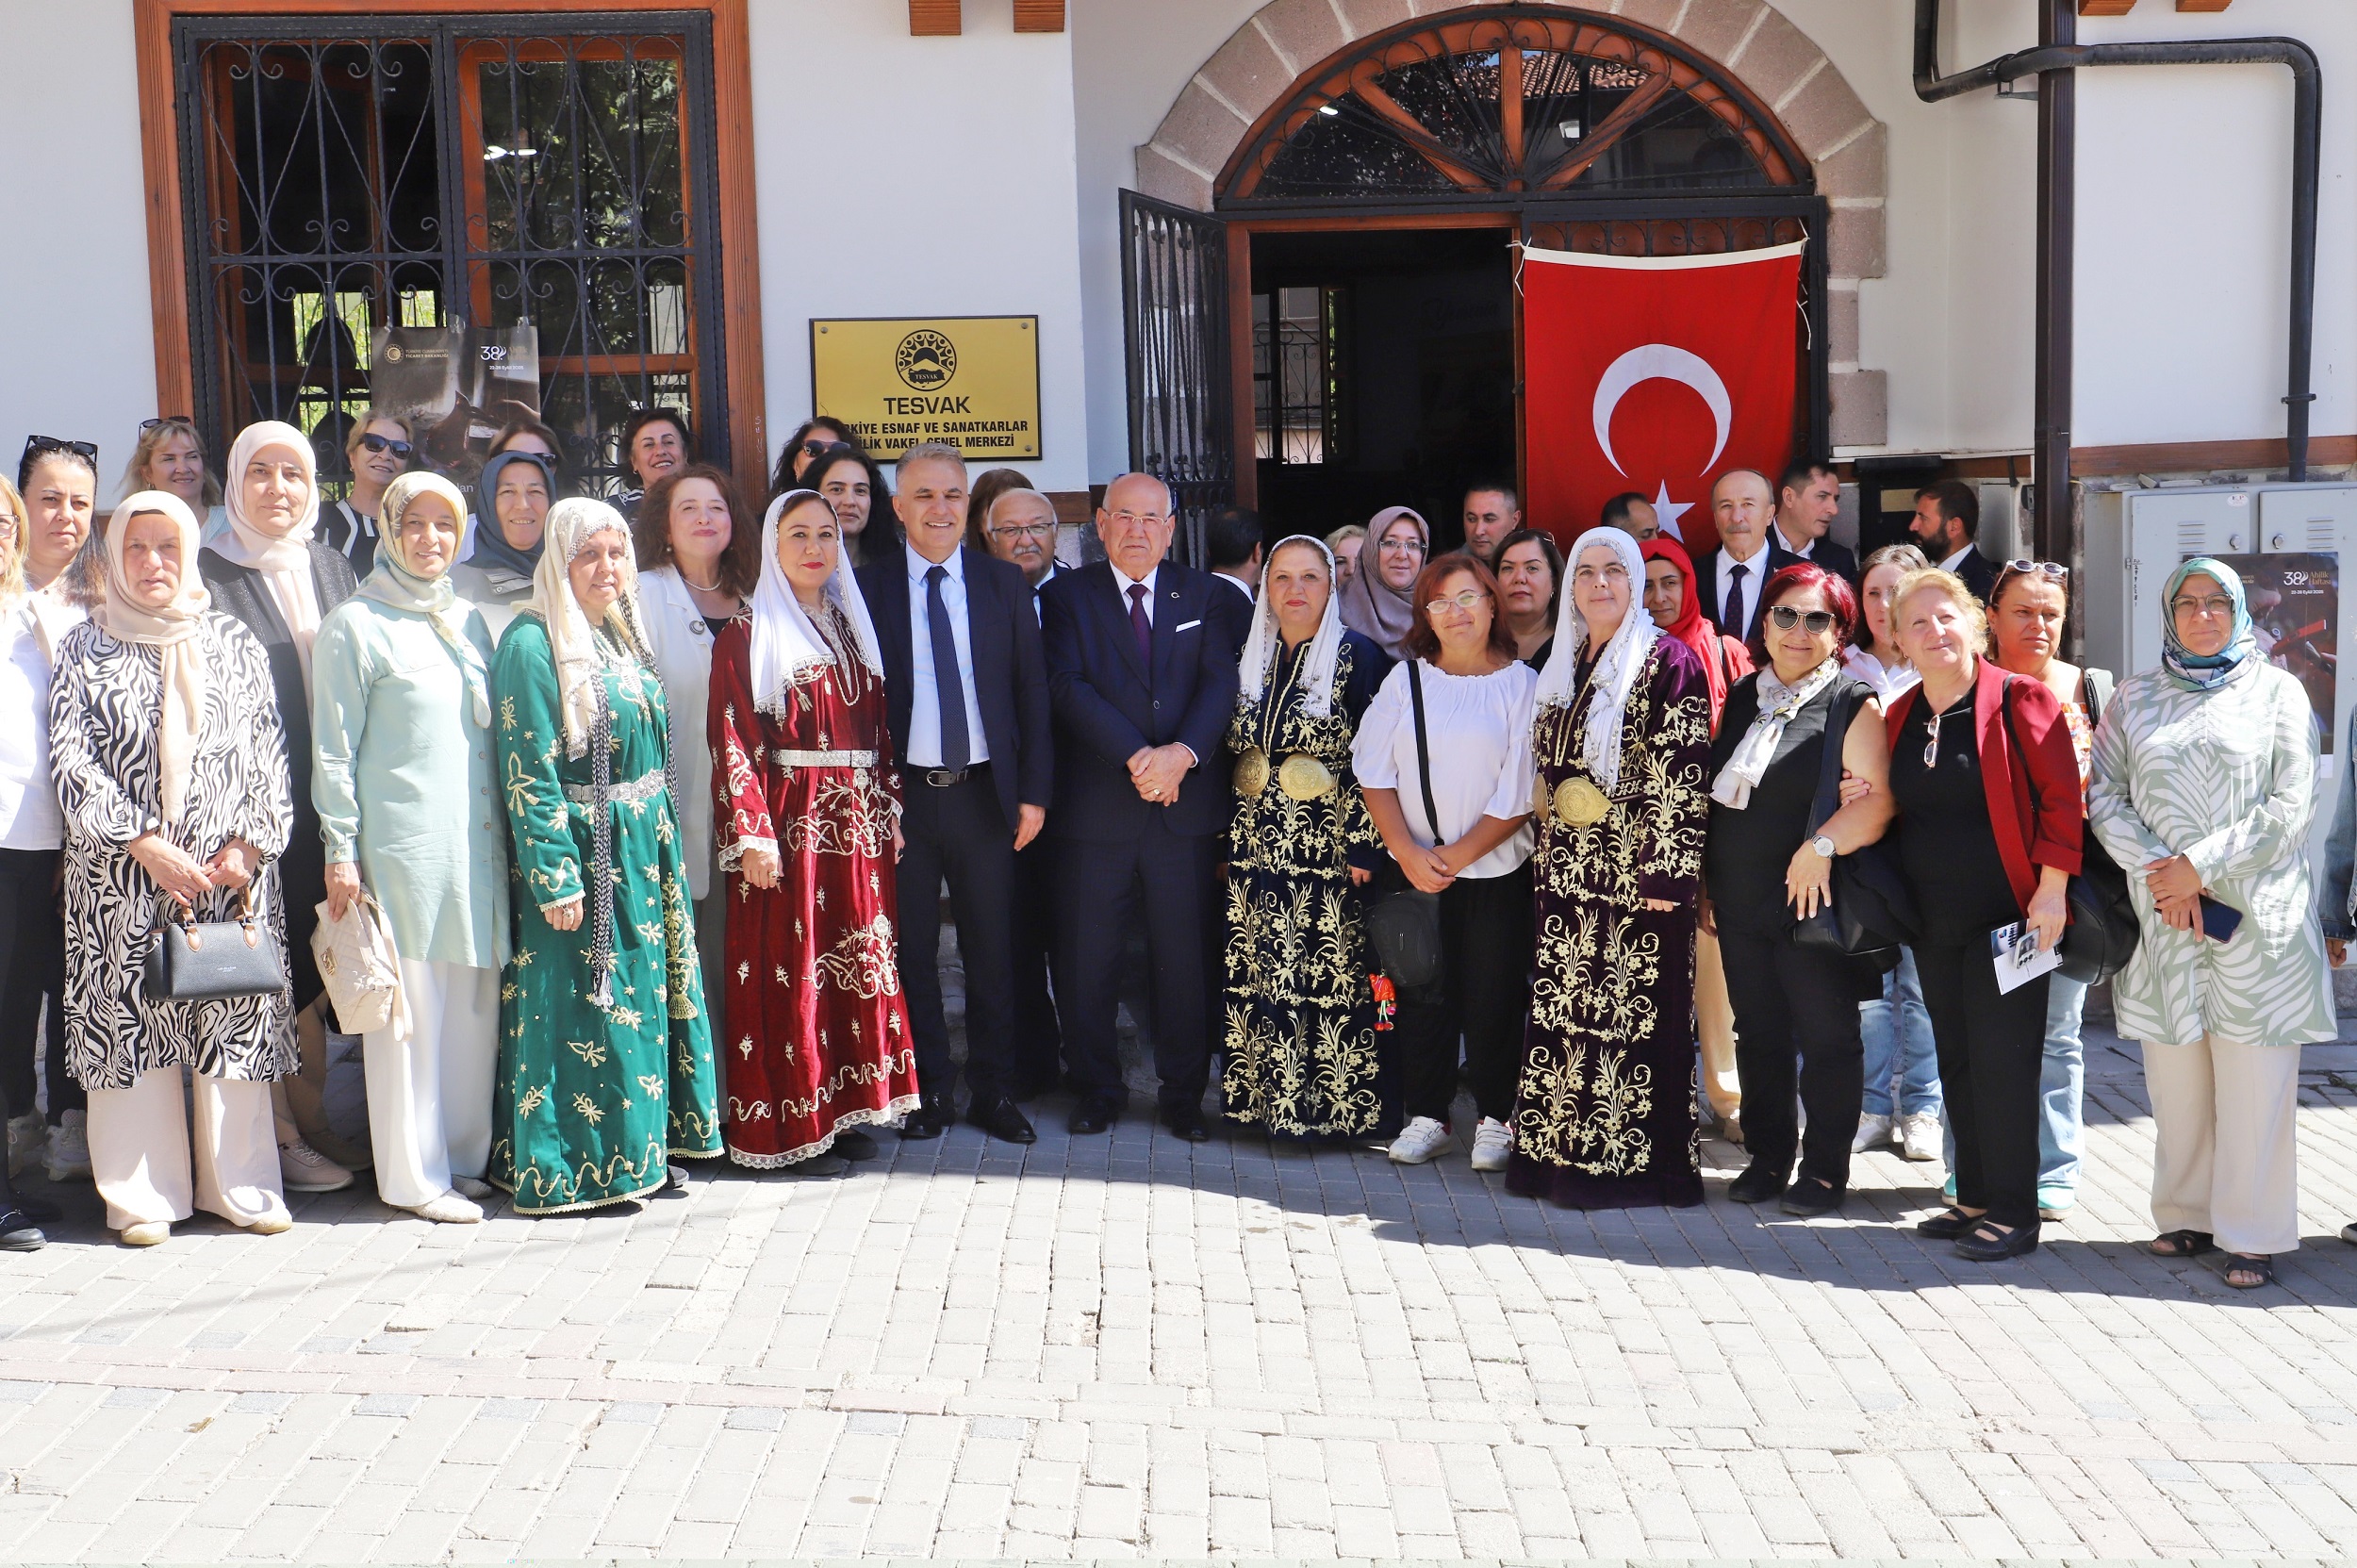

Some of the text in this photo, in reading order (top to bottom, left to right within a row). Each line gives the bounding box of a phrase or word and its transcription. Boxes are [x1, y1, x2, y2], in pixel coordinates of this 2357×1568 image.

[882, 396, 971, 415] TESVAK
[882, 422, 920, 434] ESNAF
[923, 421, 939, 434] VE
[943, 421, 1029, 433] SANATKARLAR
[965, 434, 1014, 448] MERKEZİ
